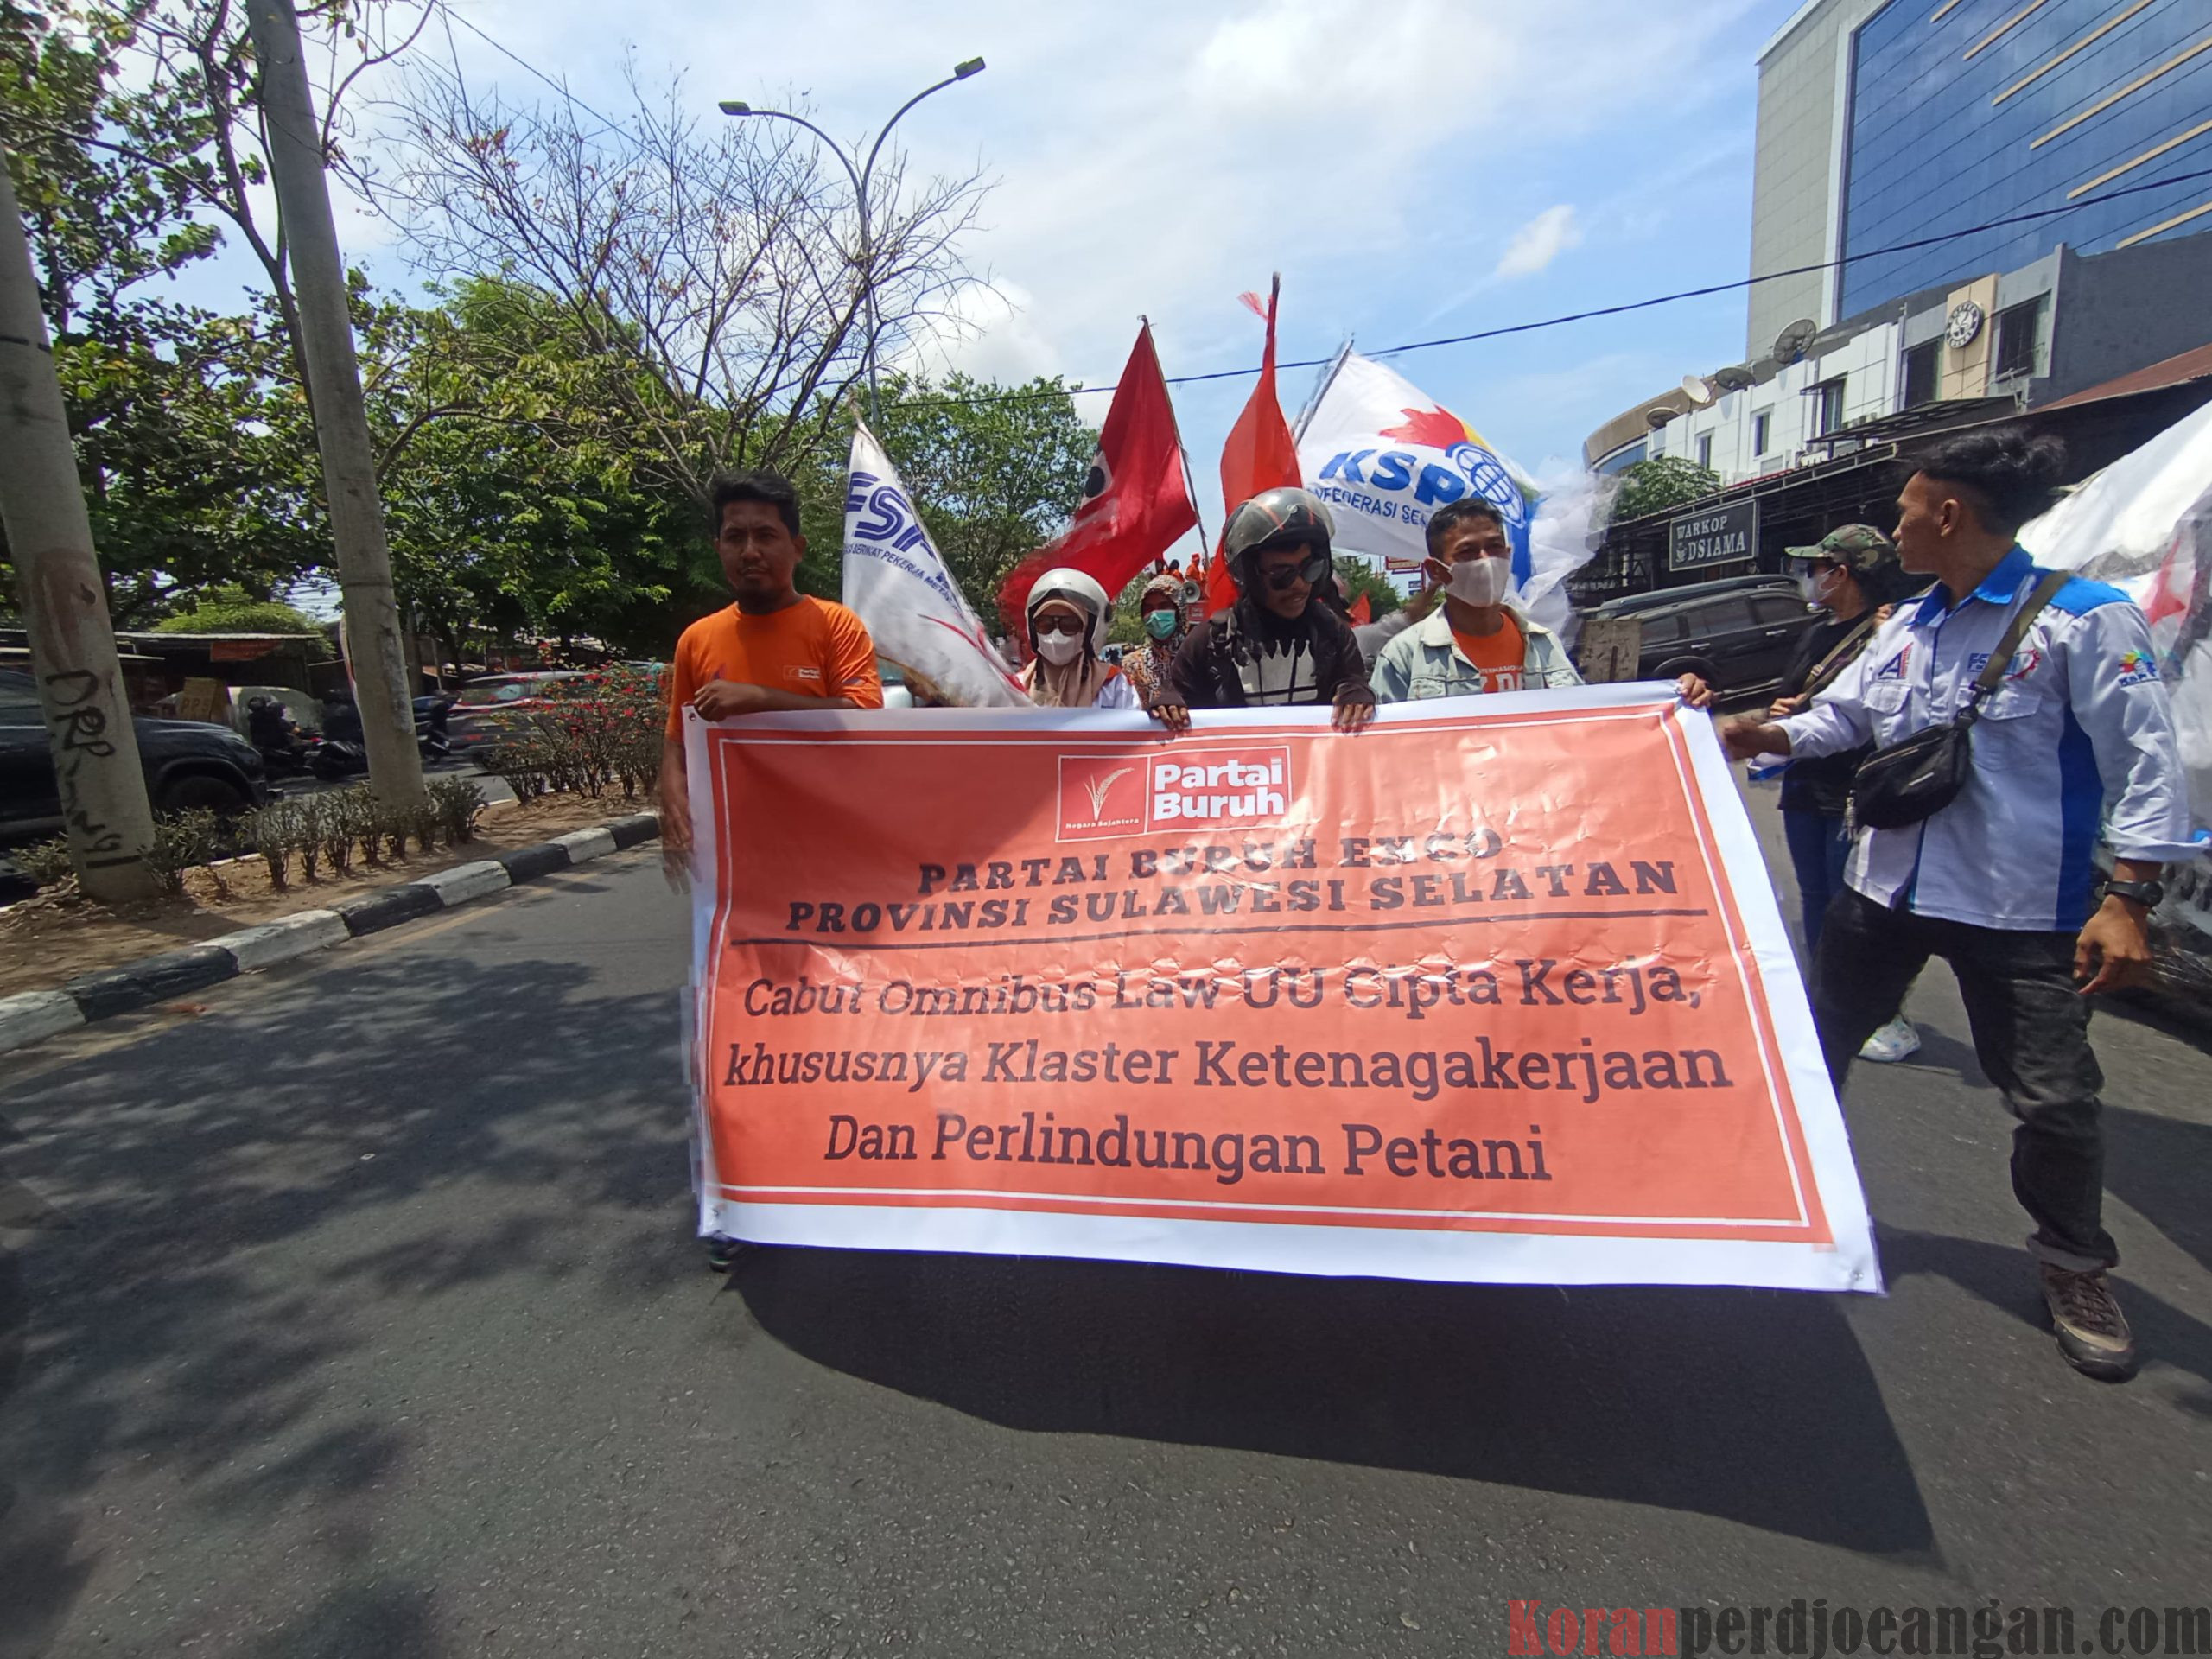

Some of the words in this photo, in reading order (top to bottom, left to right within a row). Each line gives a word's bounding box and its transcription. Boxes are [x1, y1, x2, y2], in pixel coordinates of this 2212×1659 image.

[1676, 516, 1728, 540] WARKOP
[881, 550, 925, 580] PEKERJA
[1154, 757, 1283, 791] Partai
[1153, 786, 1285, 821] Buruh
[918, 855, 1109, 894] PARTAI
[785, 897, 1030, 933] PROVINSI
[1047, 879, 1347, 925] SULAWESI
[1370, 861, 1679, 911] SELATAN
[744, 976, 862, 1017] Cabut
[879, 975, 1096, 1017] Omnibus
[1111, 969, 1218, 1010] Law
[1243, 967, 1327, 1010] UU
[1344, 963, 1501, 1020] Cipta
[1515, 955, 1702, 1016] Kerja,
[723, 1043, 968, 1093] khususnya
[982, 1039, 1179, 1086] Klaster
[1193, 1037, 1735, 1103] Ketenagakerjaan
[824, 1114, 918, 1160] Dan
[932, 1111, 1325, 1185] Perlindungan
[1342, 1123, 1553, 1181] Petani
